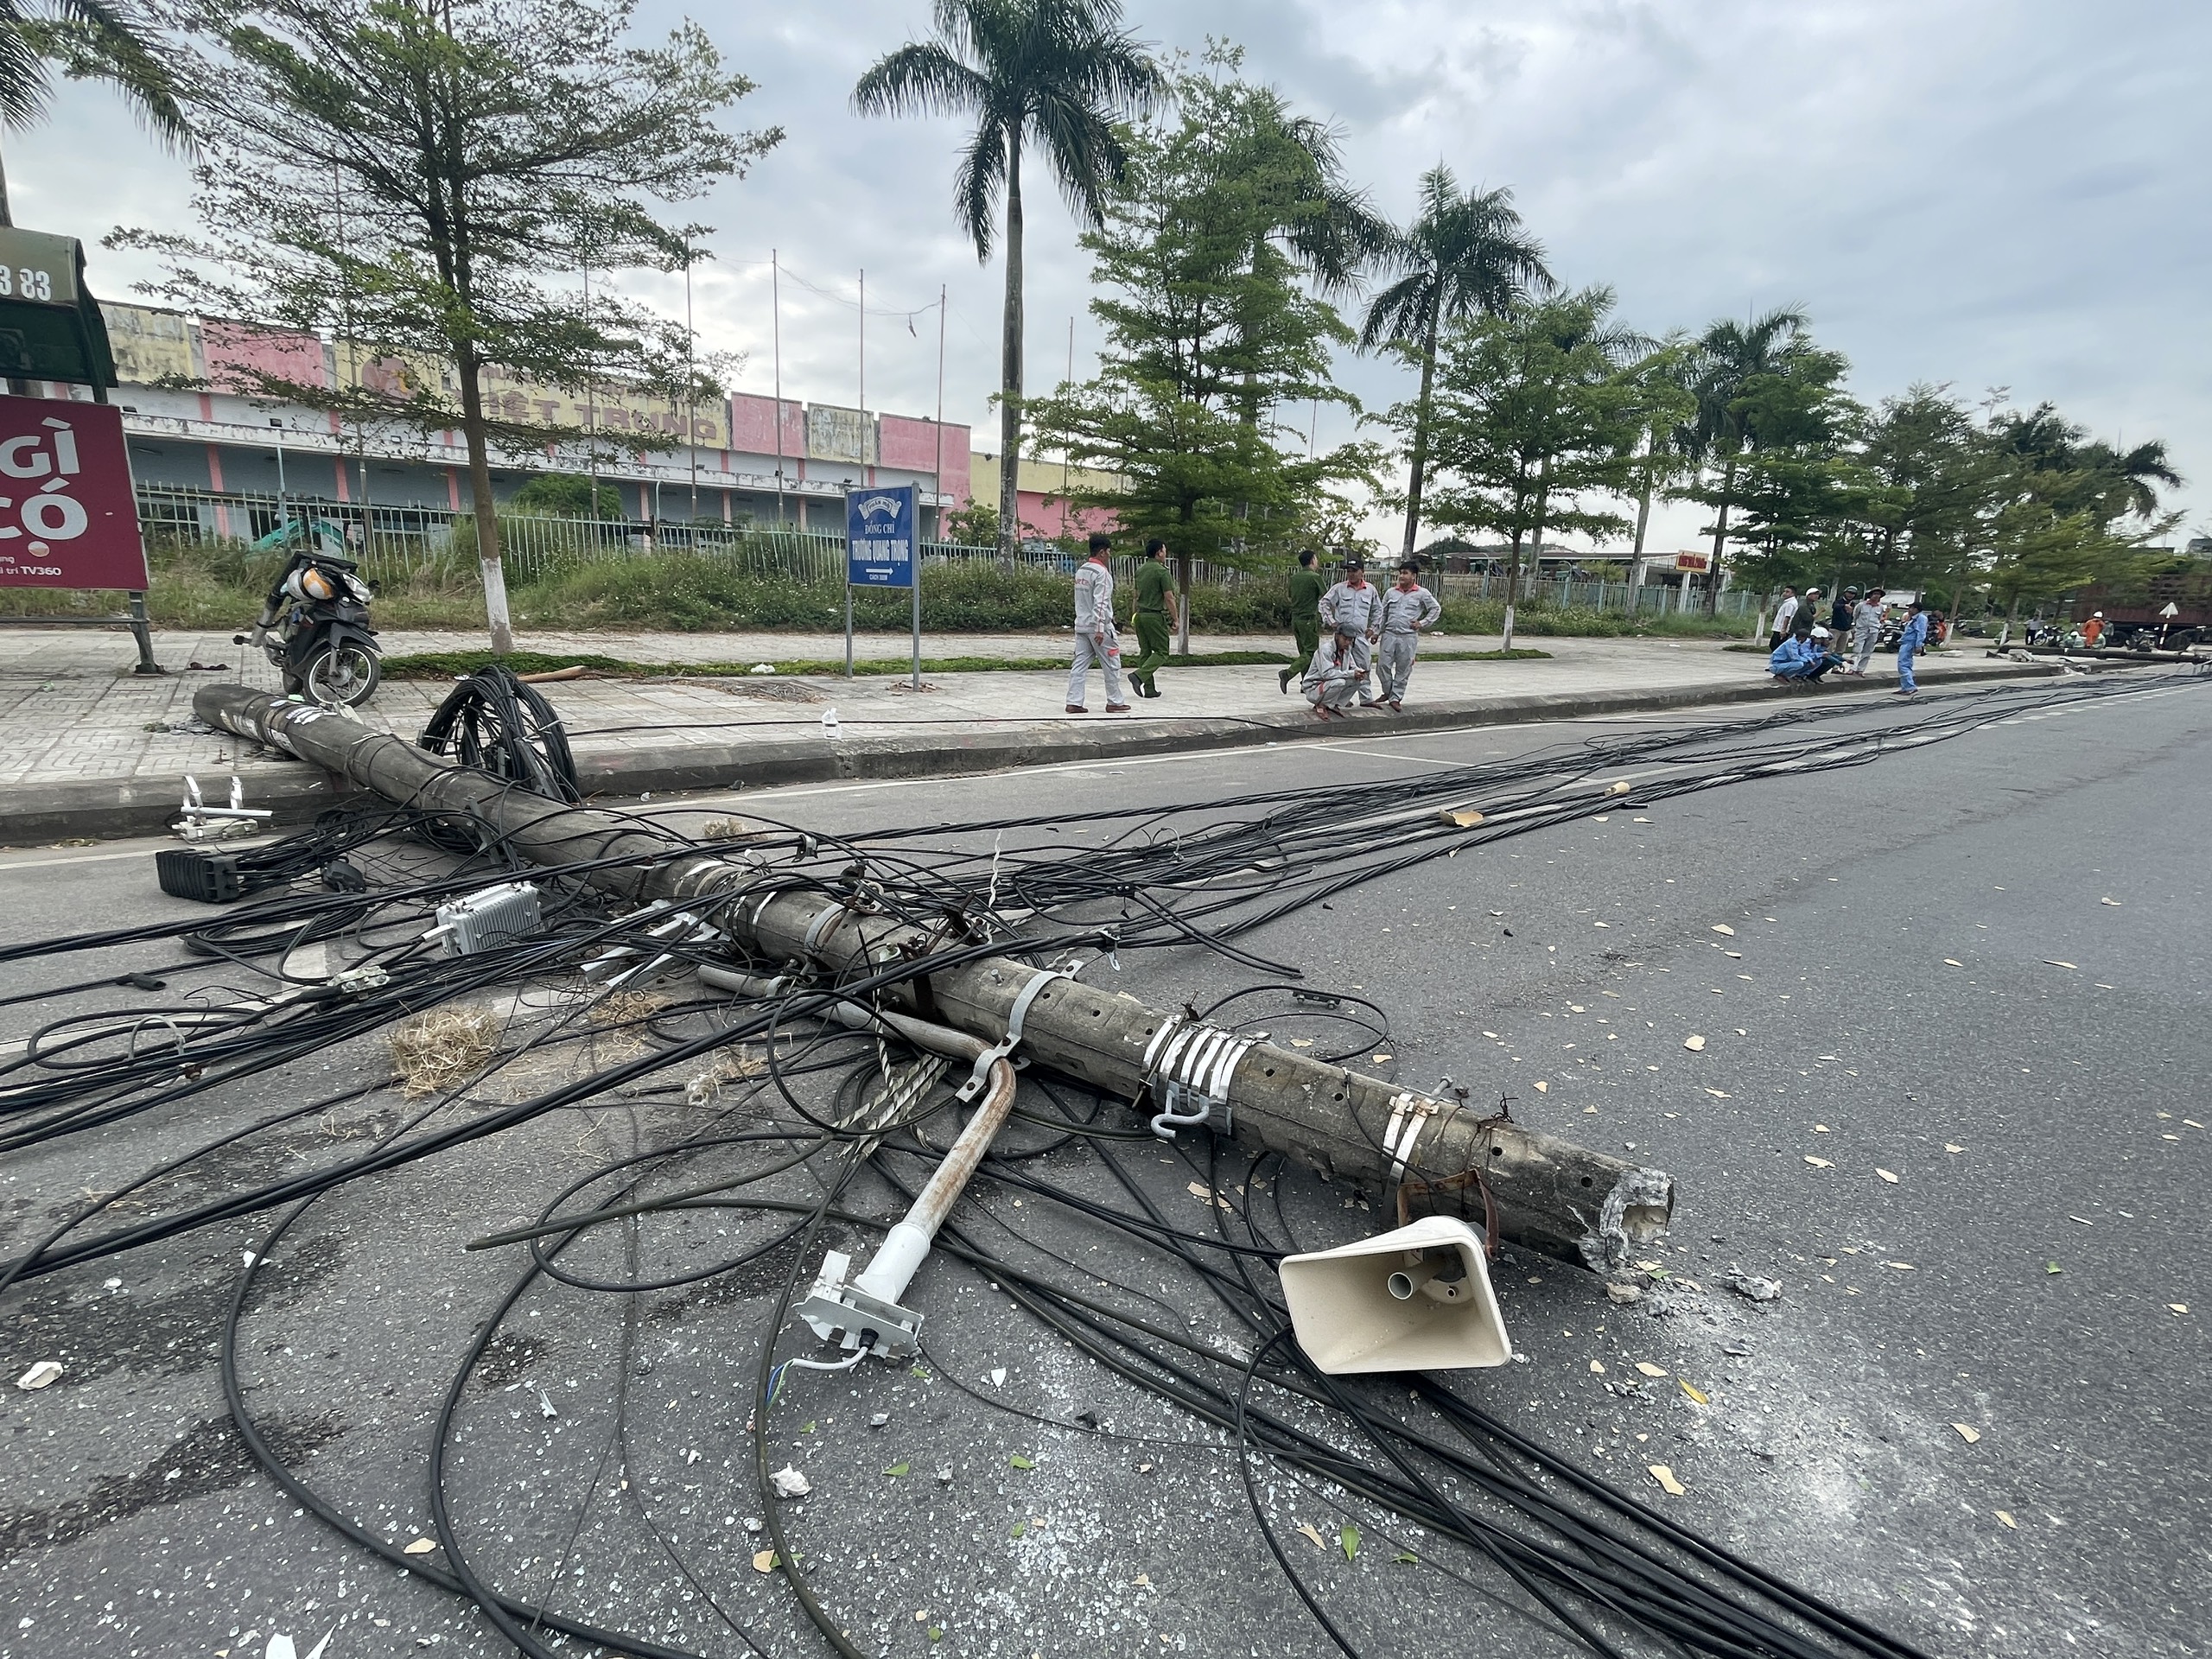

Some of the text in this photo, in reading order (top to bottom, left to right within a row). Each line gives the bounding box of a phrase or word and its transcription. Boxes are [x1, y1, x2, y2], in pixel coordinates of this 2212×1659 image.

[19, 268, 52, 302] 83
[574, 404, 716, 440] TRUNG
[0, 417, 80, 479] GÌ
[882, 521, 895, 534] CHÍ
[20, 566, 62, 575] TV360
